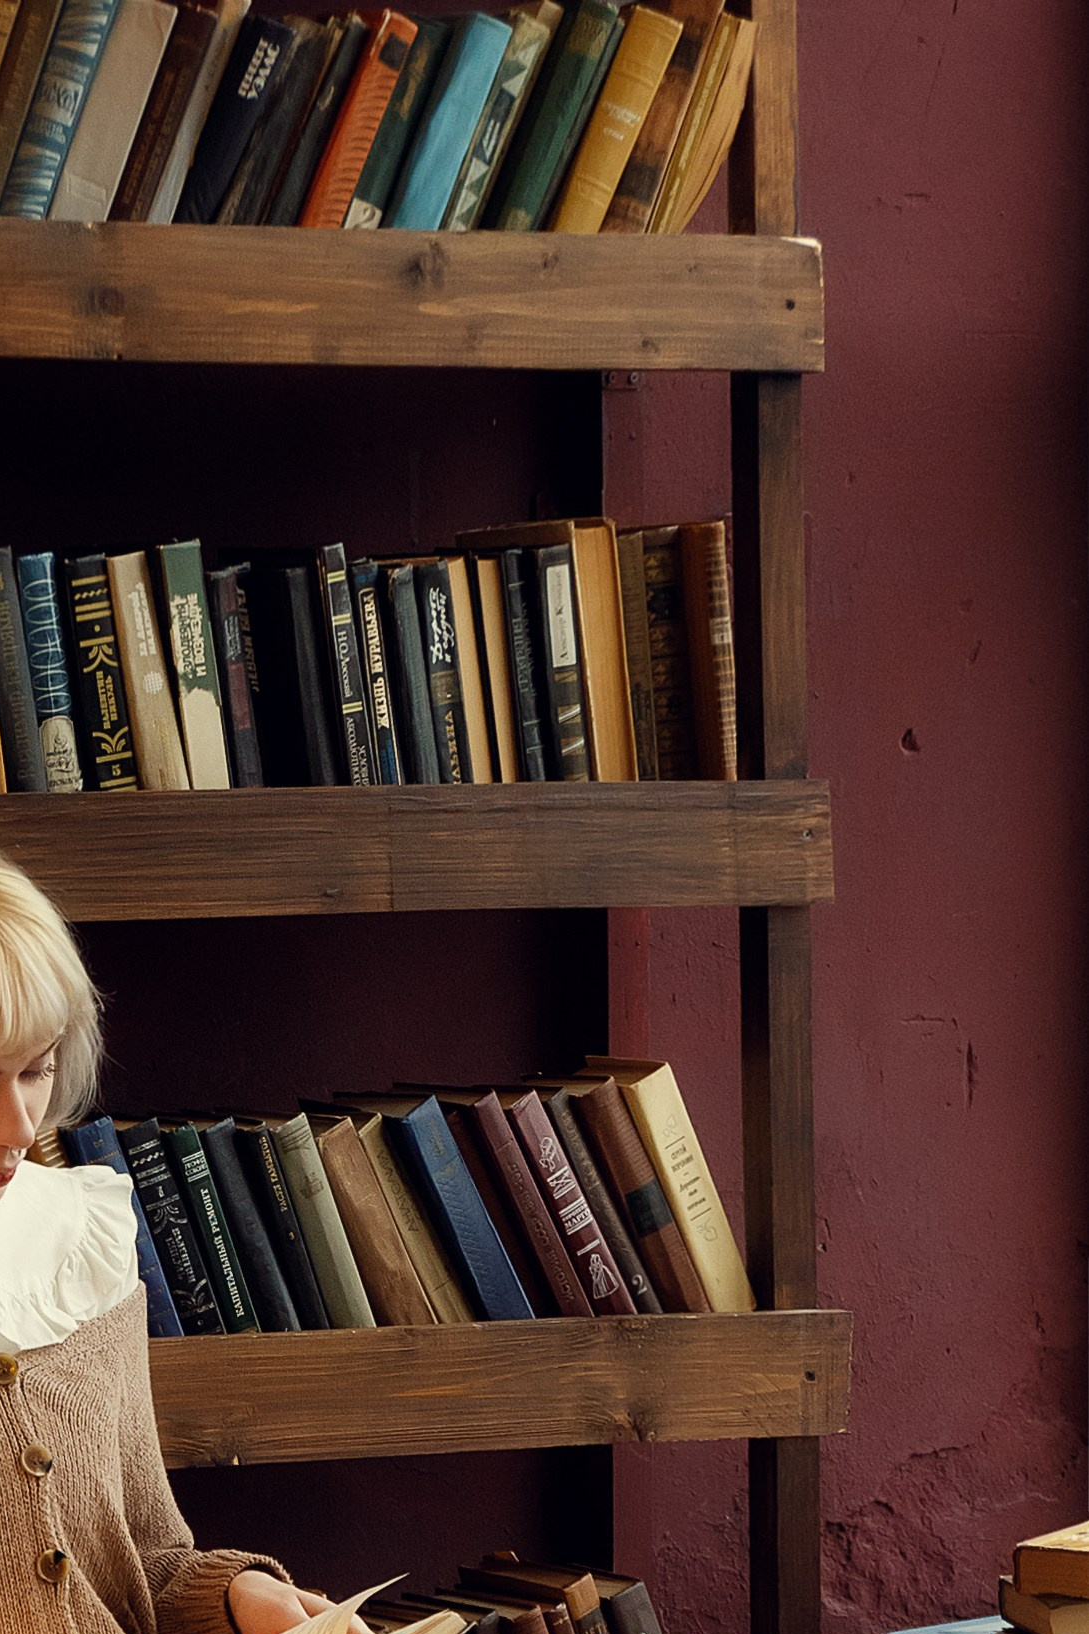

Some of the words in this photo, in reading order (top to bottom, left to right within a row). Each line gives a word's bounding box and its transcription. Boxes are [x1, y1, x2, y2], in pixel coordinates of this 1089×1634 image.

[175, 602, 193, 673] ЗЛОДЕЯНИЯ
[186, 592, 205, 666] ВОЗМЕЗДИЕ
[363, 591, 384, 674] МУРАВЬЕВА
[429, 586, 444, 665] Дороги
[438, 592, 455, 650] судьбы
[195, 667, 207, 677] И
[94, 670, 111, 730] ВАЛЕНТИН
[104, 674, 119, 723] ПИКУЛЬ
[373, 676, 390, 730] ЖИЗНЬ
[112, 764, 122, 777] 5
[258, 1136, 278, 1184] ГАМЗАТОВ
[200, 1187, 219, 1236] РЕМОНТ
[270, 1184, 288, 1213] РАСУЛ
[563, 1209, 593, 1229] МАРГО
[529, 1215, 551, 1246] СССР
[214, 1236, 245, 1318] КАПИТАЛЬНЫЙ
[543, 1249, 575, 1303] ИСТОРИЯ
[630, 1273, 648, 1295] 2
